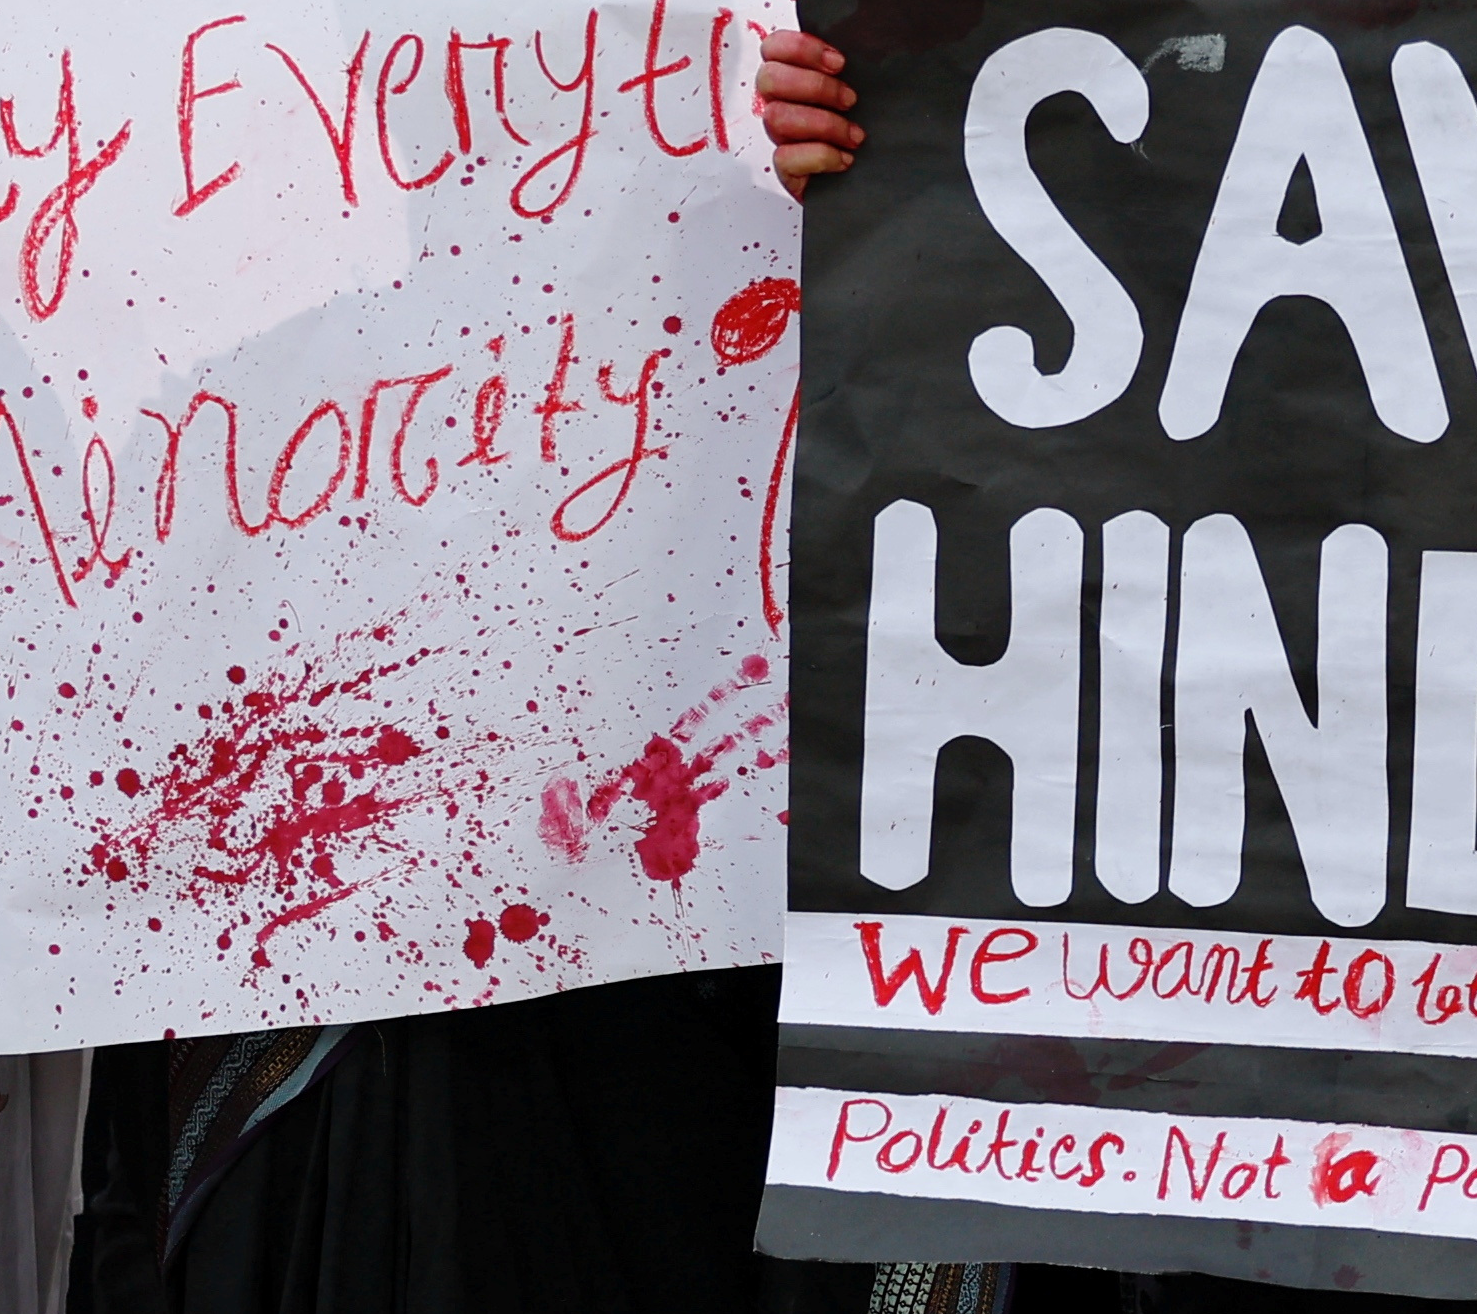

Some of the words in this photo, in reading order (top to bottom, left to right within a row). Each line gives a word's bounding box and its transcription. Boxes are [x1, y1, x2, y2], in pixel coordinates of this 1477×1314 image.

[853, 920, 1039, 1016] We
[1061, 932, 1279, 1009] want
[1294, 940, 1397, 1020] to
[1156, 1124, 1292, 1202] Not
[1316, 1137, 1381, 1205] a
